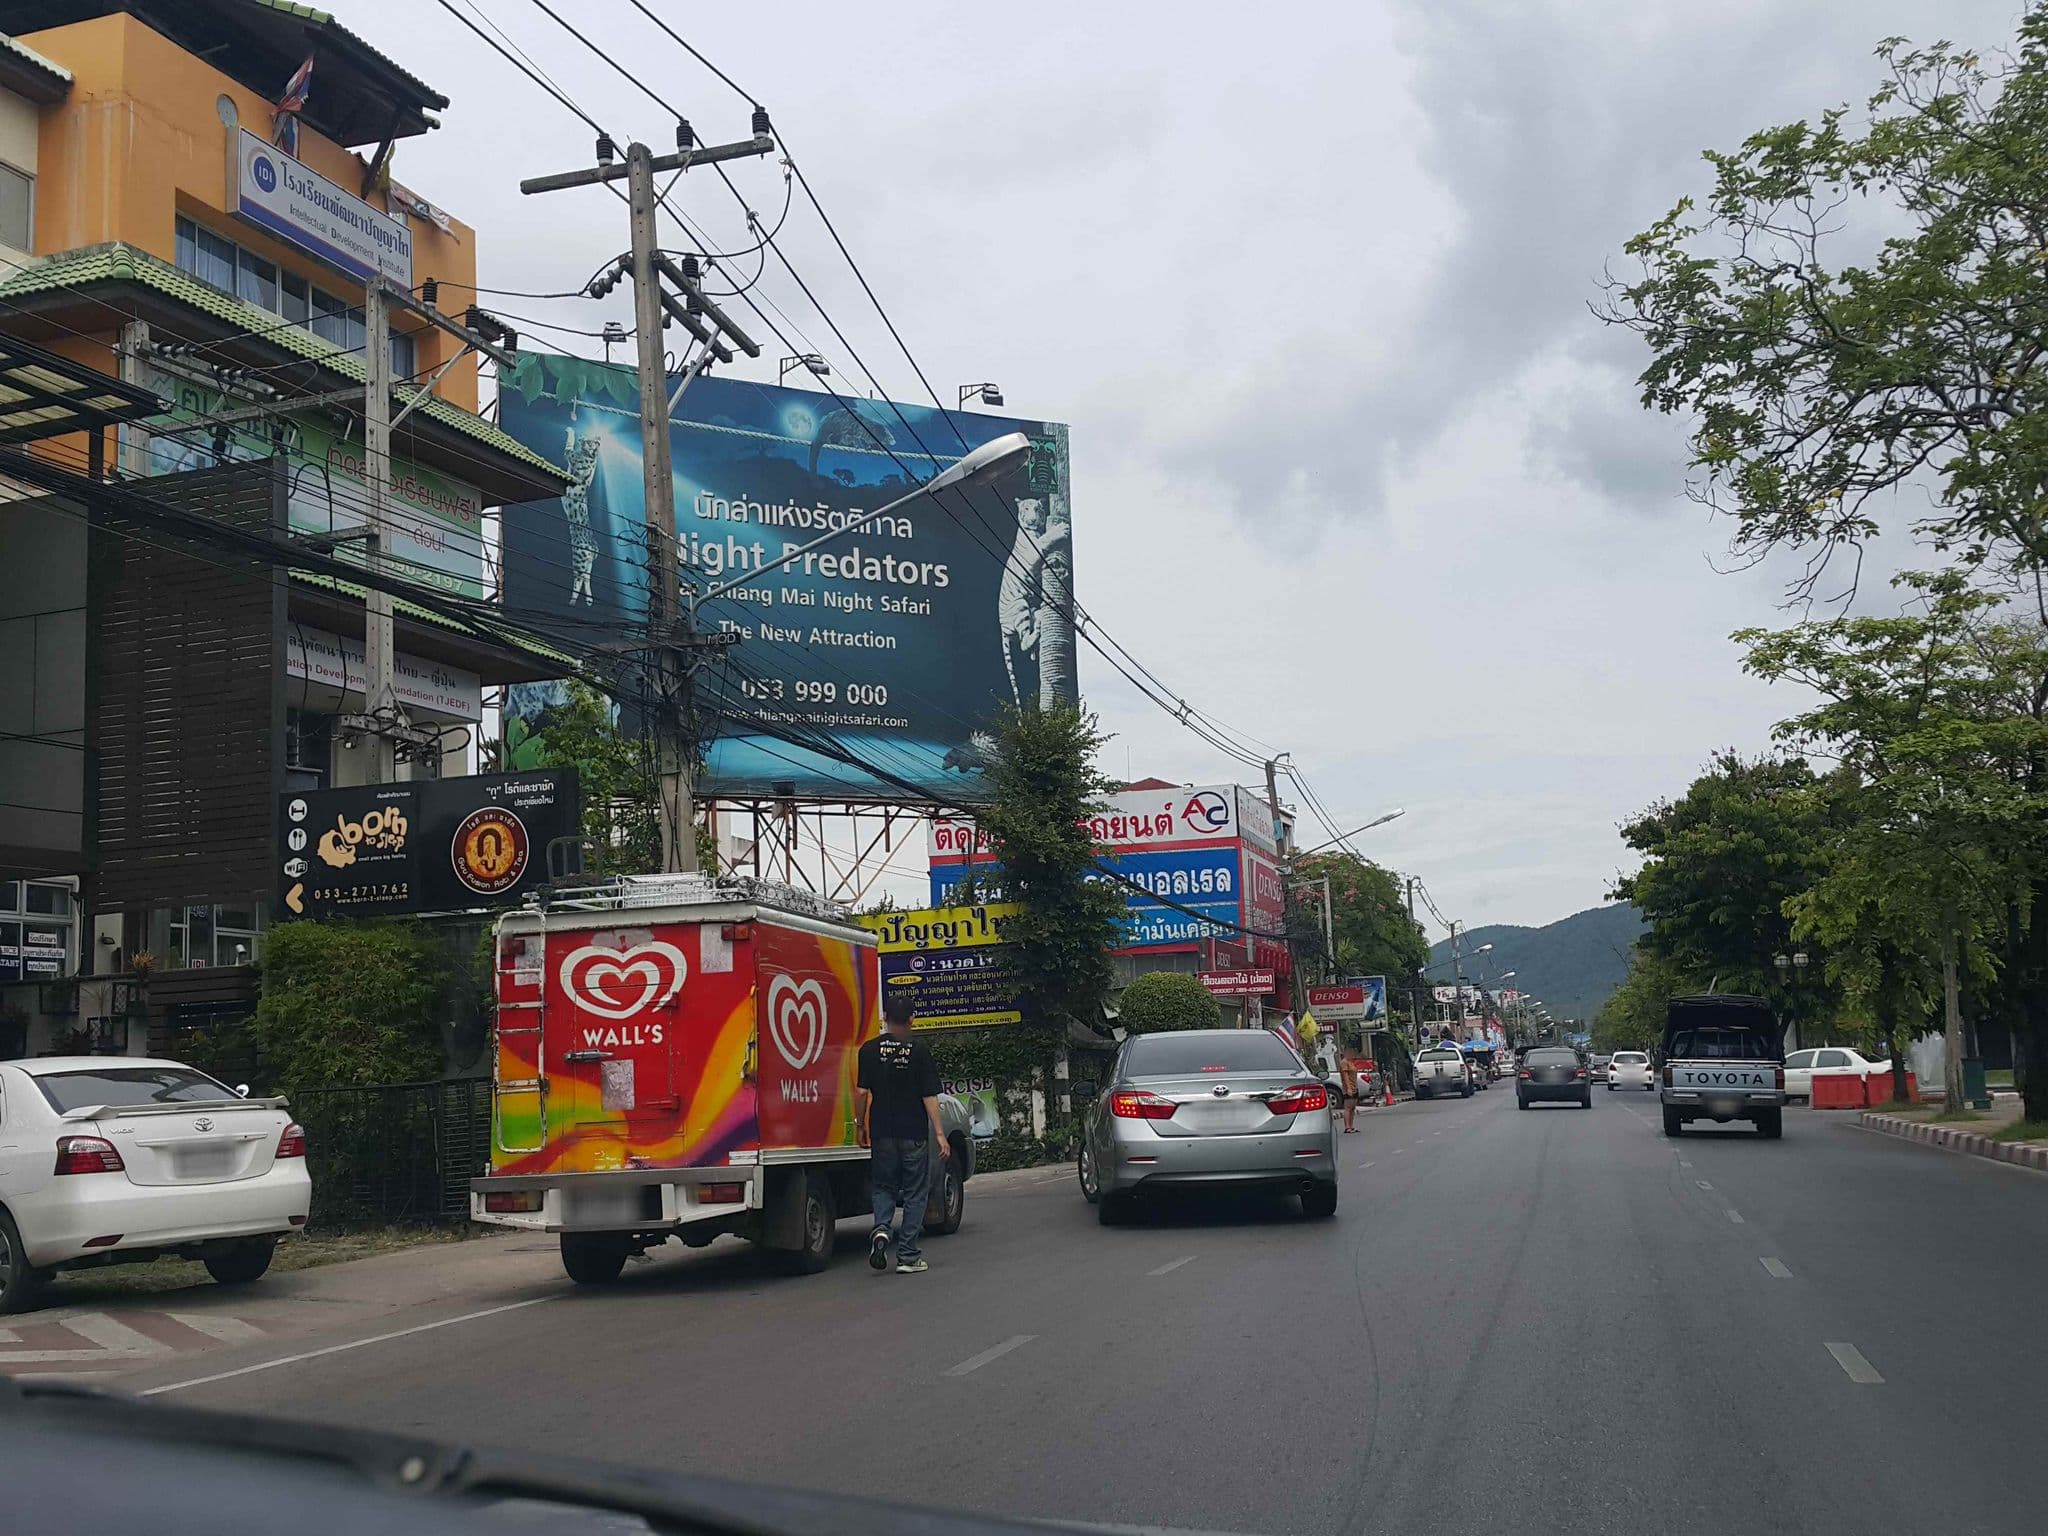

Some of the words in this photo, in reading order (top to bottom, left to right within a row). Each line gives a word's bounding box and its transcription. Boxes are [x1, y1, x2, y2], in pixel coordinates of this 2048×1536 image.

[258, 165, 273, 184] IDI
[289, 203, 328, 235] Intellectual
[331, 227, 375, 262] Development
[378, 254, 406, 277] Institute
[782, 541, 950, 588] Predators
[781, 586, 815, 606] Mai
[823, 590, 874, 613] Night
[881, 596, 931, 615] Safari
[718, 620, 753, 639] The
[760, 622, 801, 644] New
[809, 628, 897, 649] Attraction
[316, 664, 366, 687] Developm
[394, 687, 434, 702] undation
[741, 678, 784, 701] 053
[794, 680, 837, 704] 999
[846, 683, 888, 706] 000
[337, 806, 408, 845] born
[365, 836, 377, 846] to
[1314, 991, 1349, 1001] DENSO
[943, 1077, 993, 1096] RCISE
[1684, 1072, 1764, 1085] TOYOTA
